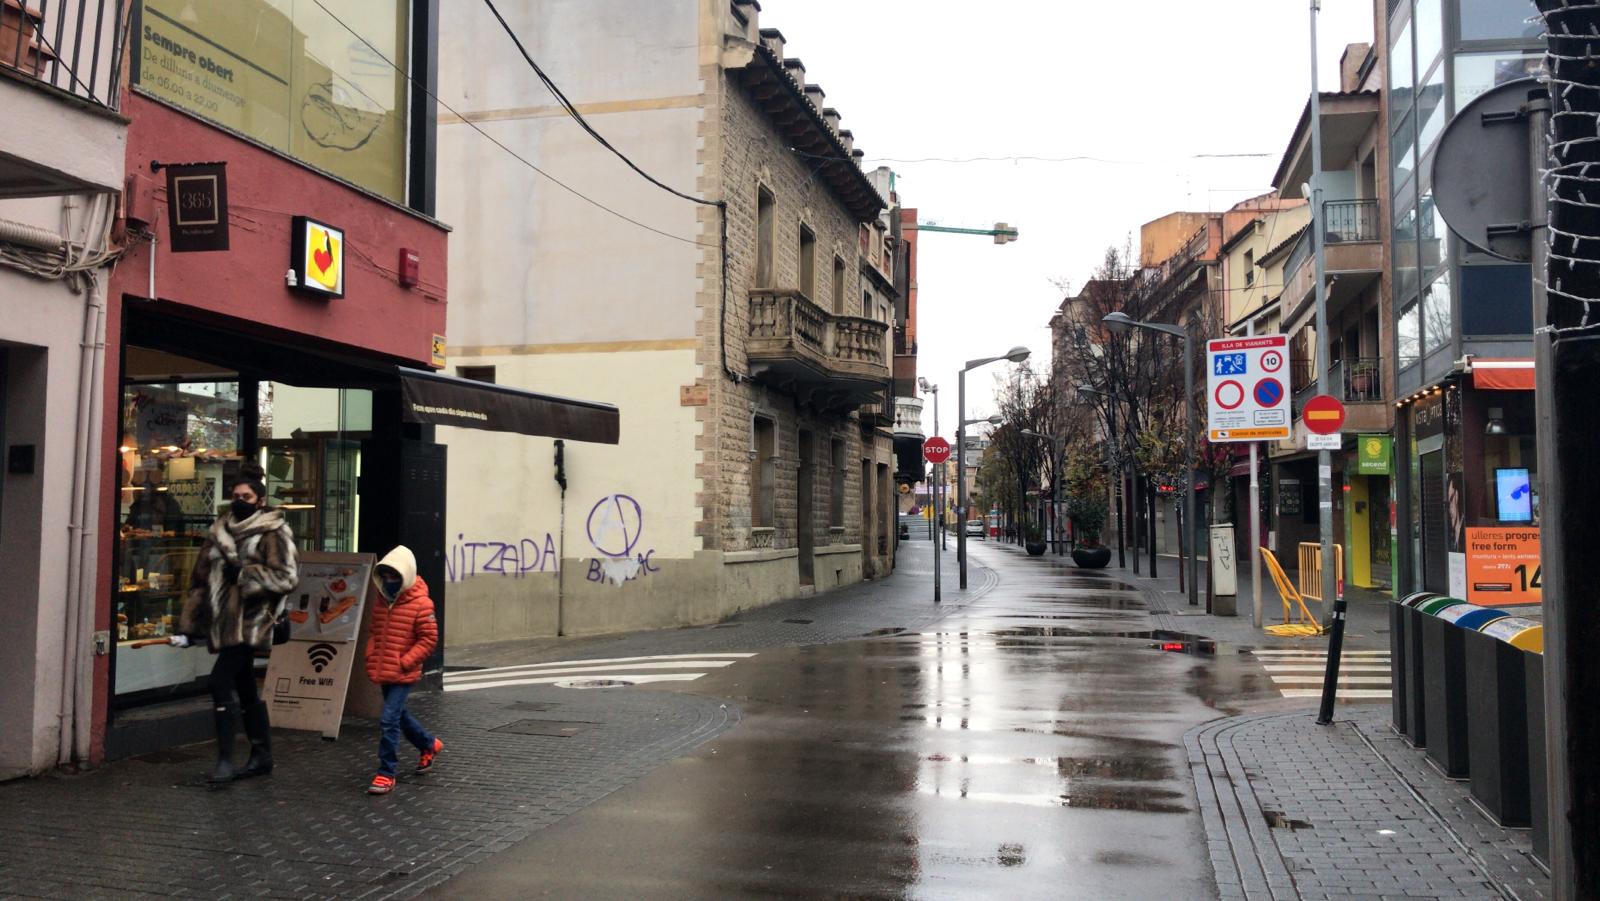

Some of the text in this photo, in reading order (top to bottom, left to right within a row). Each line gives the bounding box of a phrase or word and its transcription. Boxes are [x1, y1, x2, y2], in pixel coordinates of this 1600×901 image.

[143, 25, 233, 82] Sempre obert
[143, 47, 157, 64] De
[159, 54, 193, 81] dilluns
[182, 191, 212, 209] 365
[1245, 339, 1273, 347] VIANANTS
[1266, 357, 1277, 366] 10
[925, 446, 949, 454] STOP
[1471, 530, 1503, 540] ulleres
[1471, 542, 1517, 551] free form
[299, 676, 334, 688] Free Wifi
